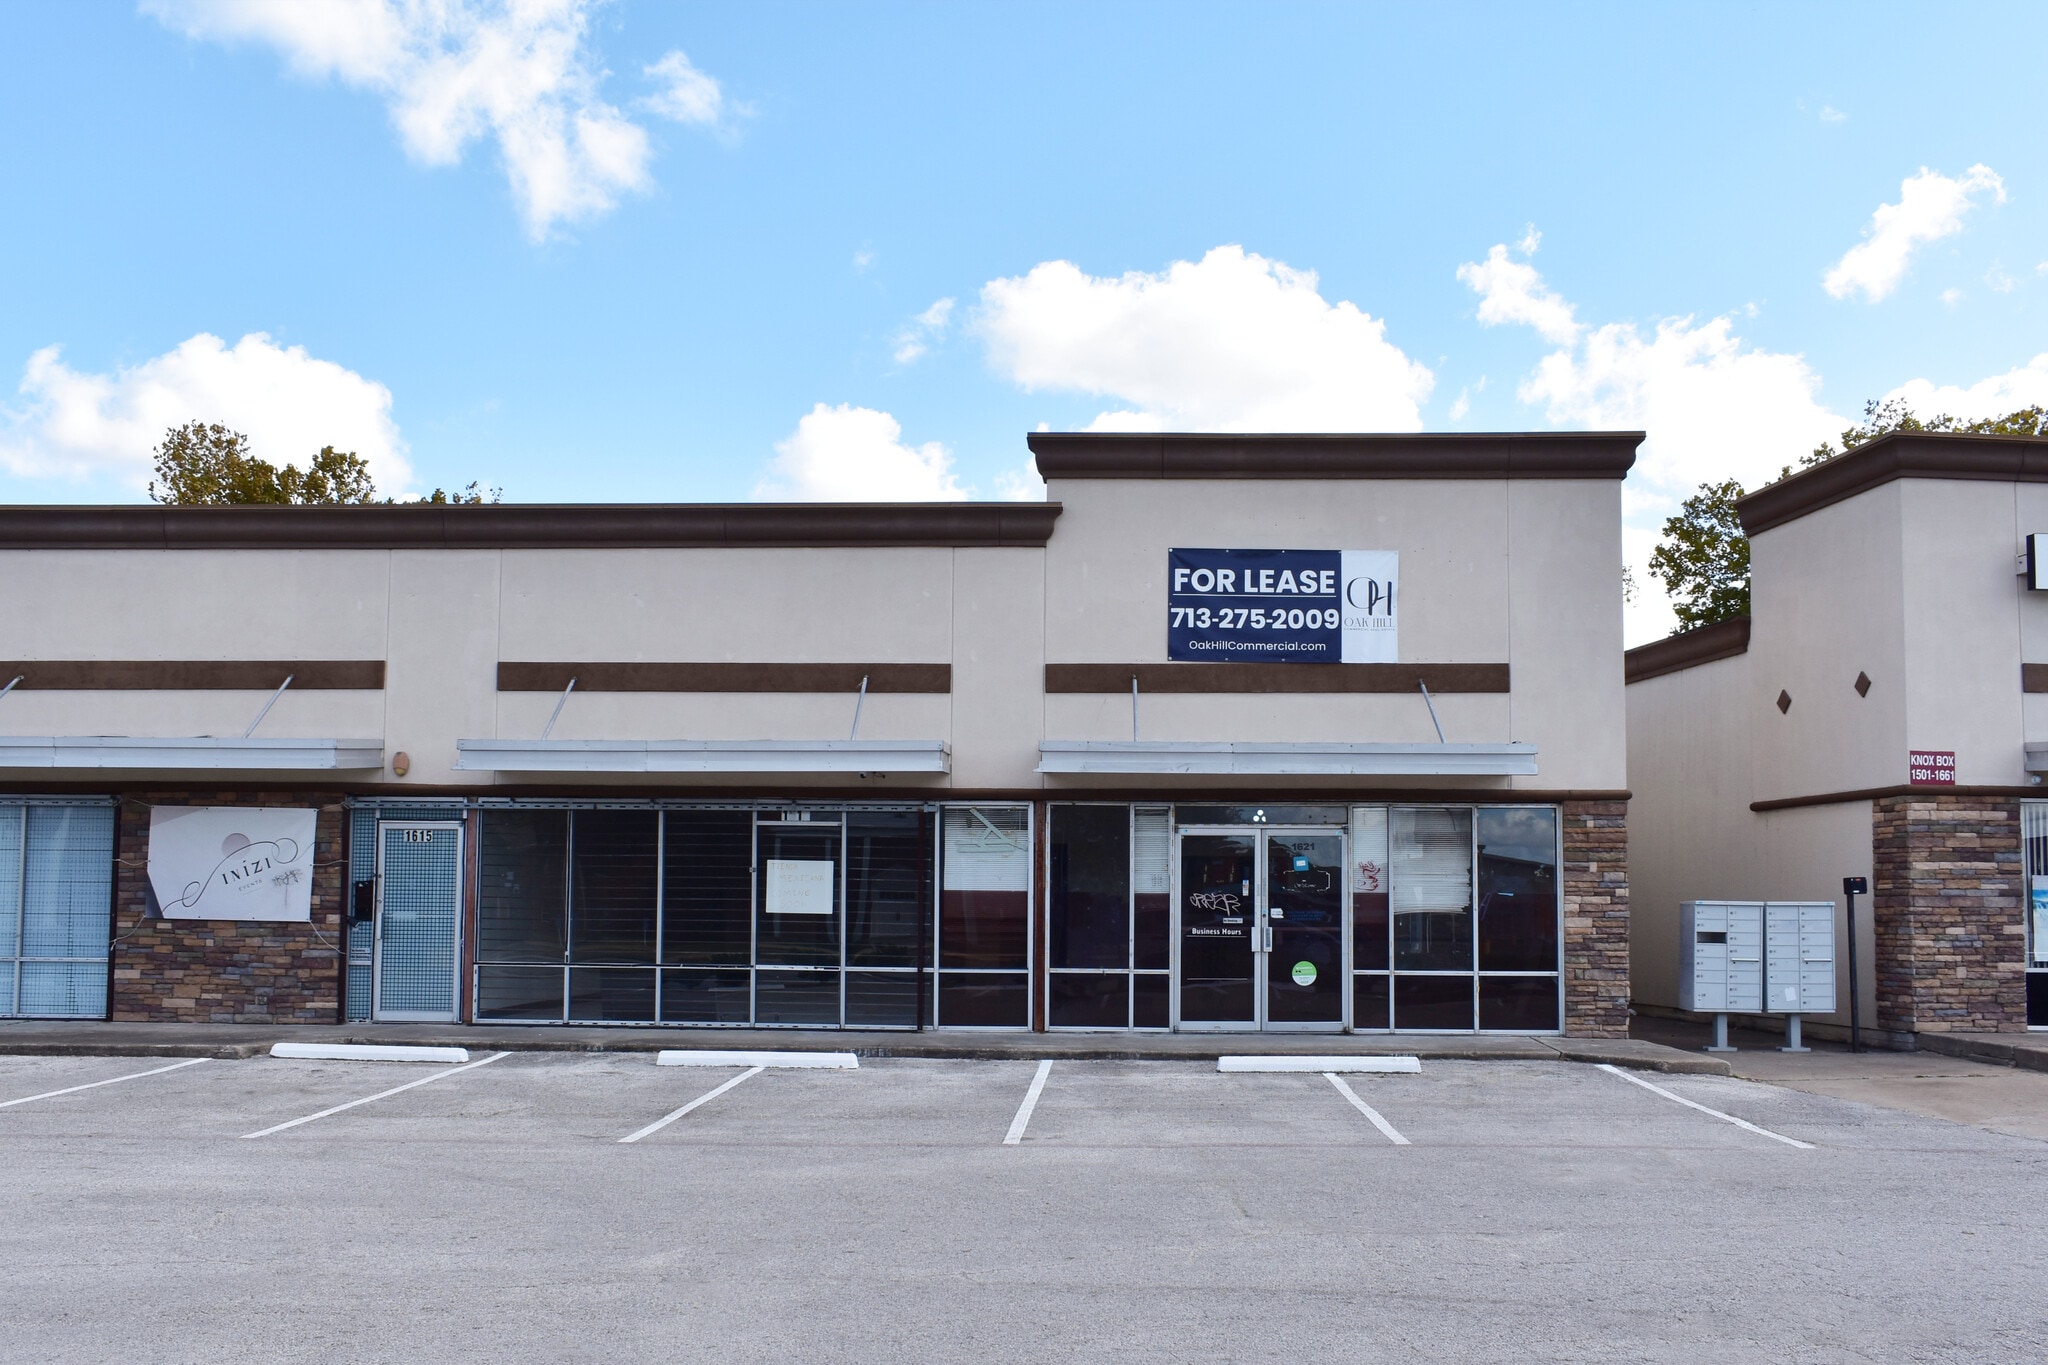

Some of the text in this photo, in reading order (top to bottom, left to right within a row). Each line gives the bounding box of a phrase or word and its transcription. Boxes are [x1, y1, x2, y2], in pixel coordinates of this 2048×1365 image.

[1174, 568, 1336, 594] FOR LEASE
[1170, 607, 1340, 630] 713-275-2009
[1343, 617, 1396, 628] OAK HILL
[1189, 640, 1327, 653] OakHillCommercial.com
[1910, 754, 1954, 767] KNOX BOX
[1911, 769, 1955, 781] 1501-1661
[405, 830, 432, 842] 1615
[1291, 842, 1315, 851] 1621
[238, 879, 263, 892] EVENTS
[1191, 927, 1242, 936] Business Hours
